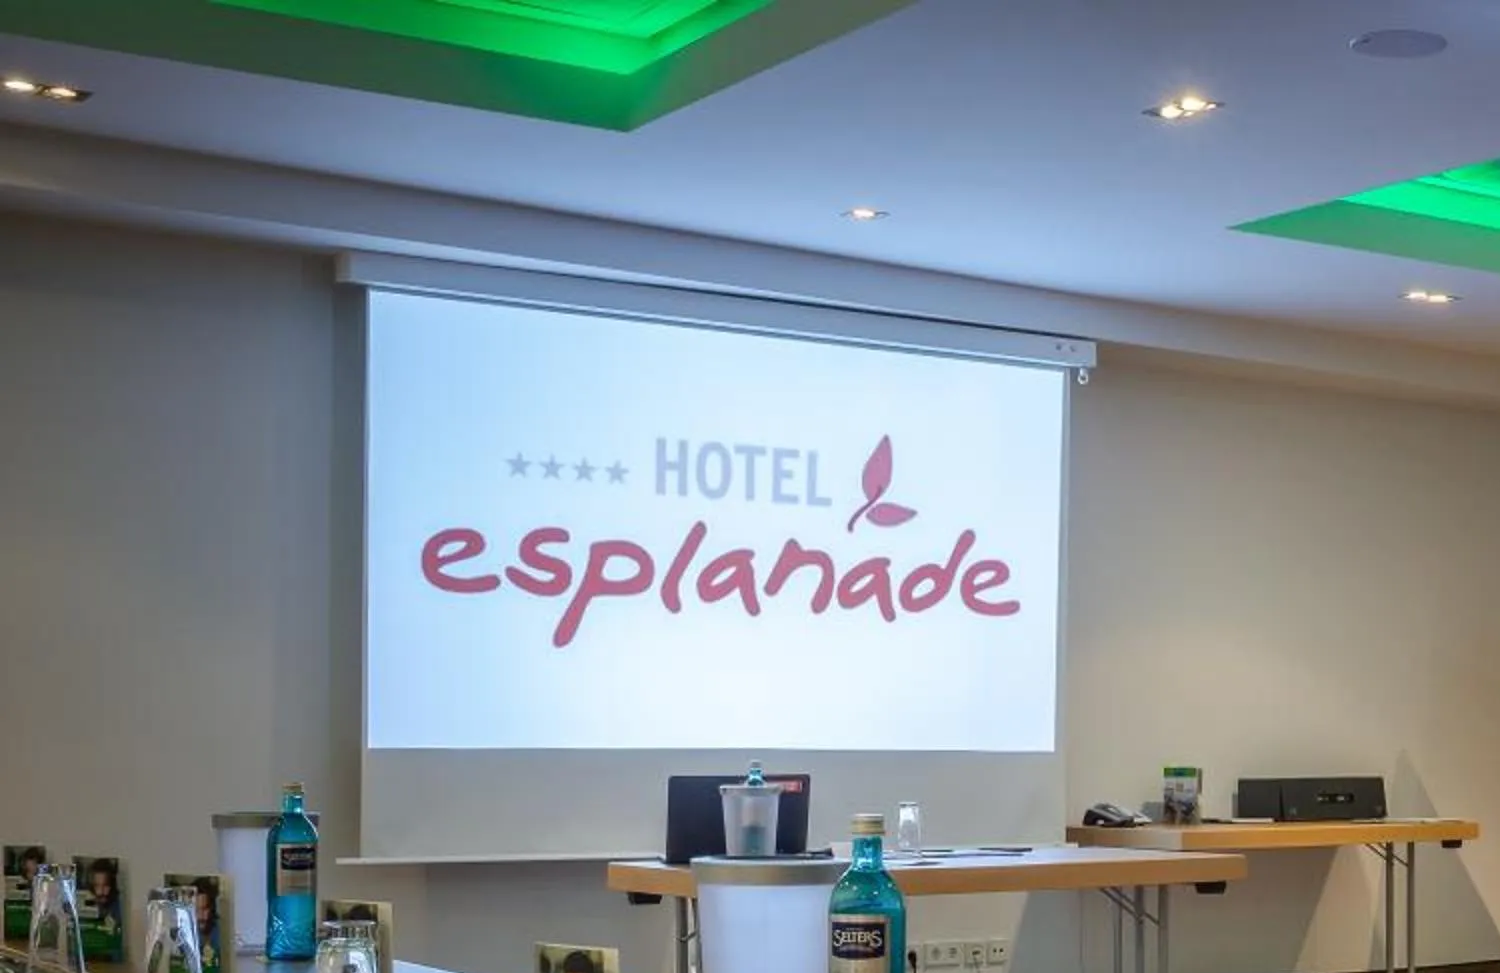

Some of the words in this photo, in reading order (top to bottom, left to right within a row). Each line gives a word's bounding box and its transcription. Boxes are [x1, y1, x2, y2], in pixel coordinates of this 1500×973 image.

[654, 437, 833, 507] HOTEL
[420, 520, 1021, 648] esplanade
[833, 929, 882, 948] SELTERS
